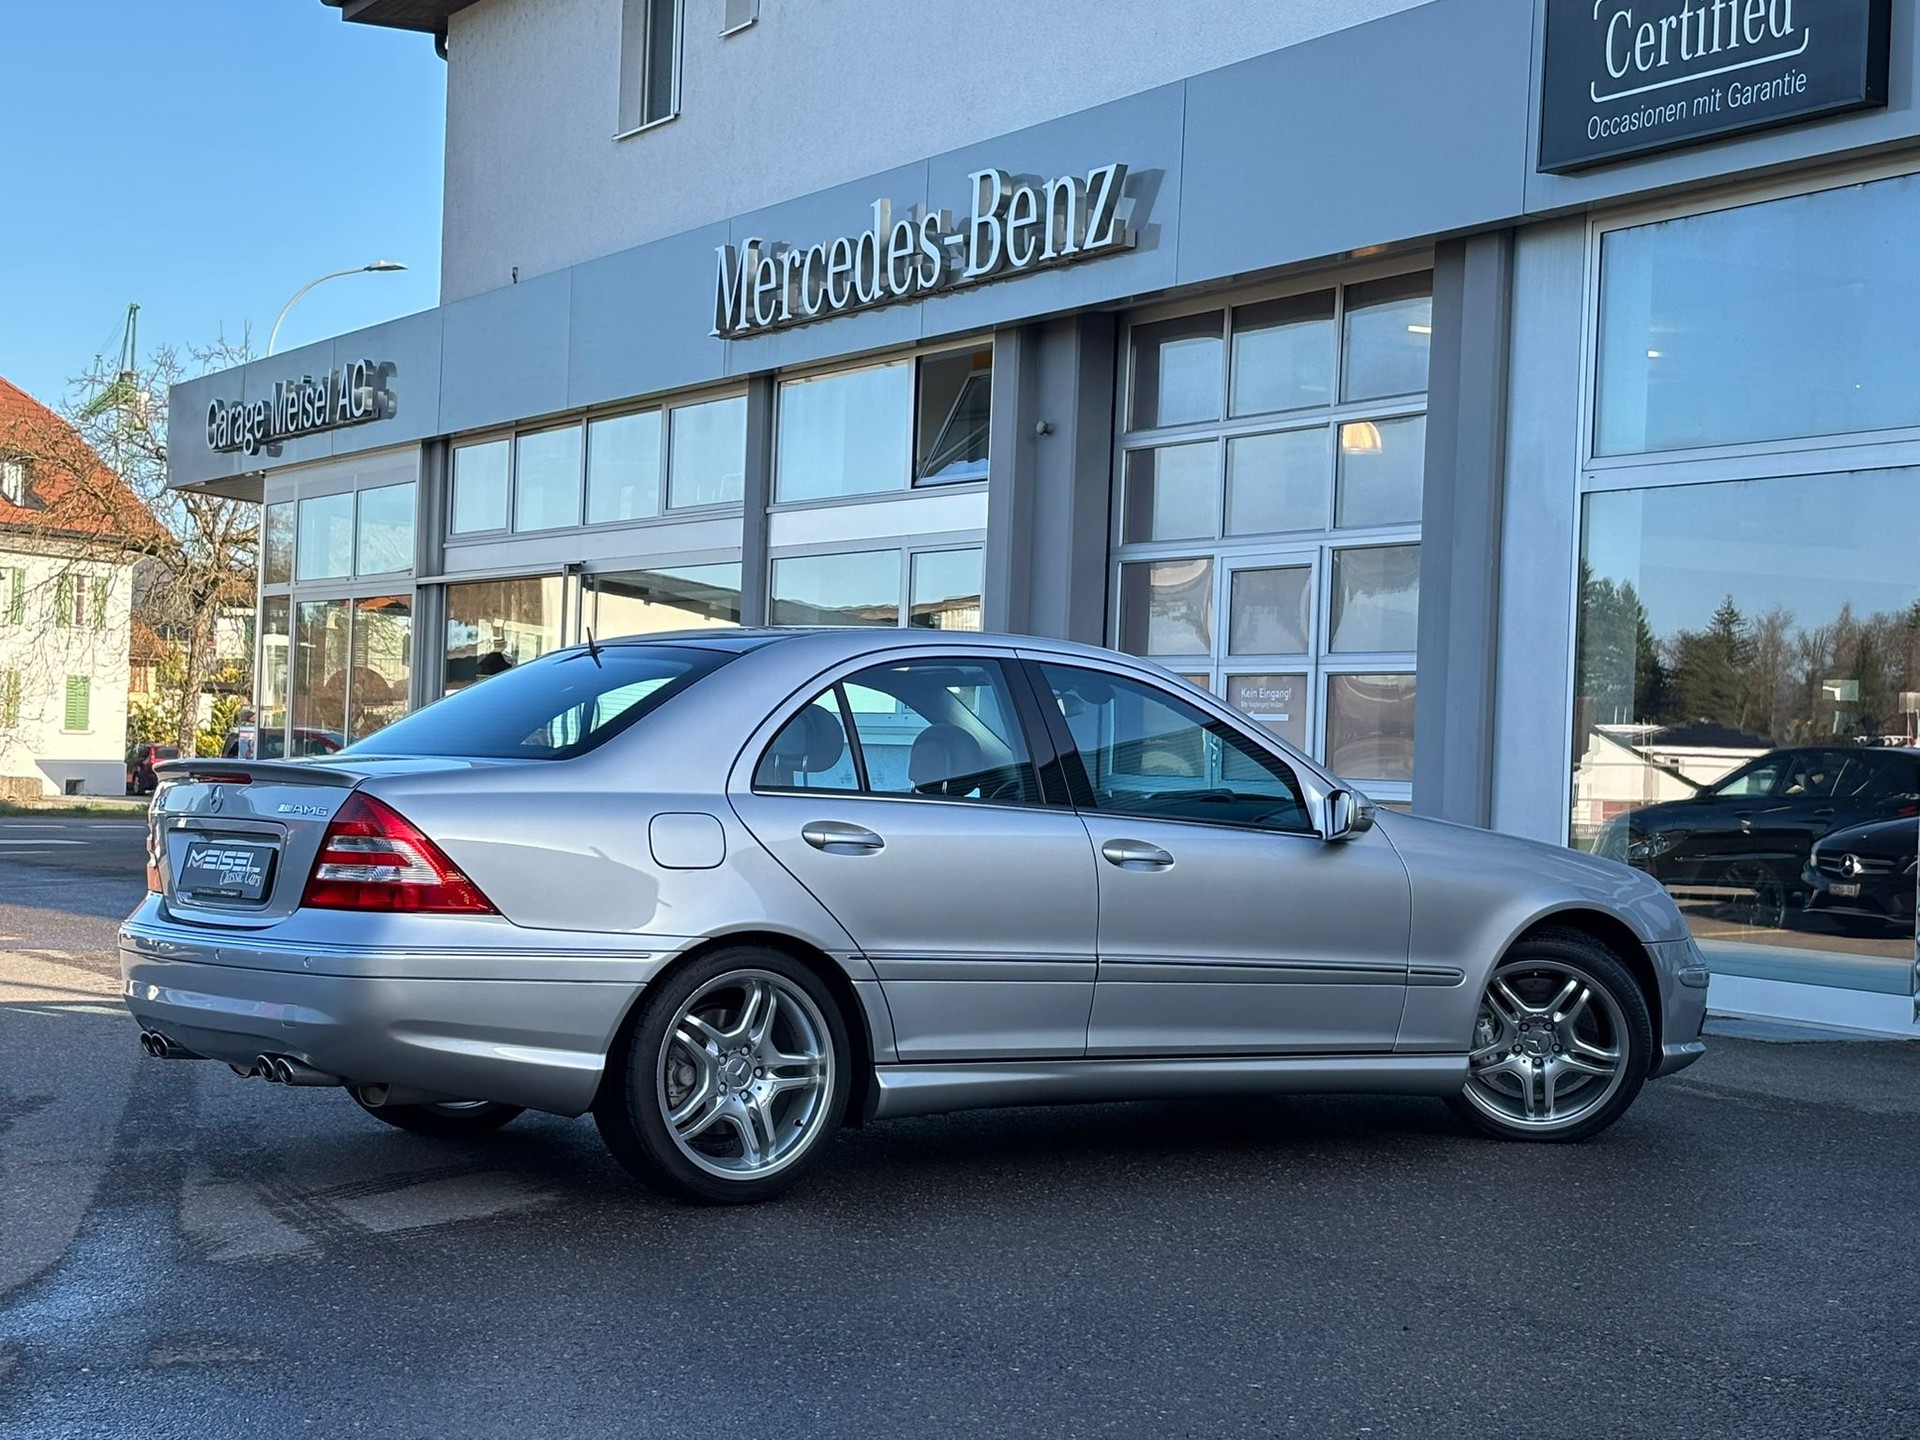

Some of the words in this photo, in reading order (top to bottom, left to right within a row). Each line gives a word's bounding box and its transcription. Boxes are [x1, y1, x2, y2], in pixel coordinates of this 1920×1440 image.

[1606, 0, 1794, 79] Certified
[1587, 98, 1687, 141] Occasionen
[1692, 87, 1722, 118] mit
[1727, 69, 1808, 109] Garantie
[709, 162, 1130, 338] Mercedes-Benz
[206, 399, 266, 456] Garage
[270, 367, 336, 436] Meisel
[336, 358, 370, 419] AG
[1240, 687, 1258, 699] Kein
[1259, 687, 1292, 701] Eingang!
[291, 804, 328, 816] AMG
